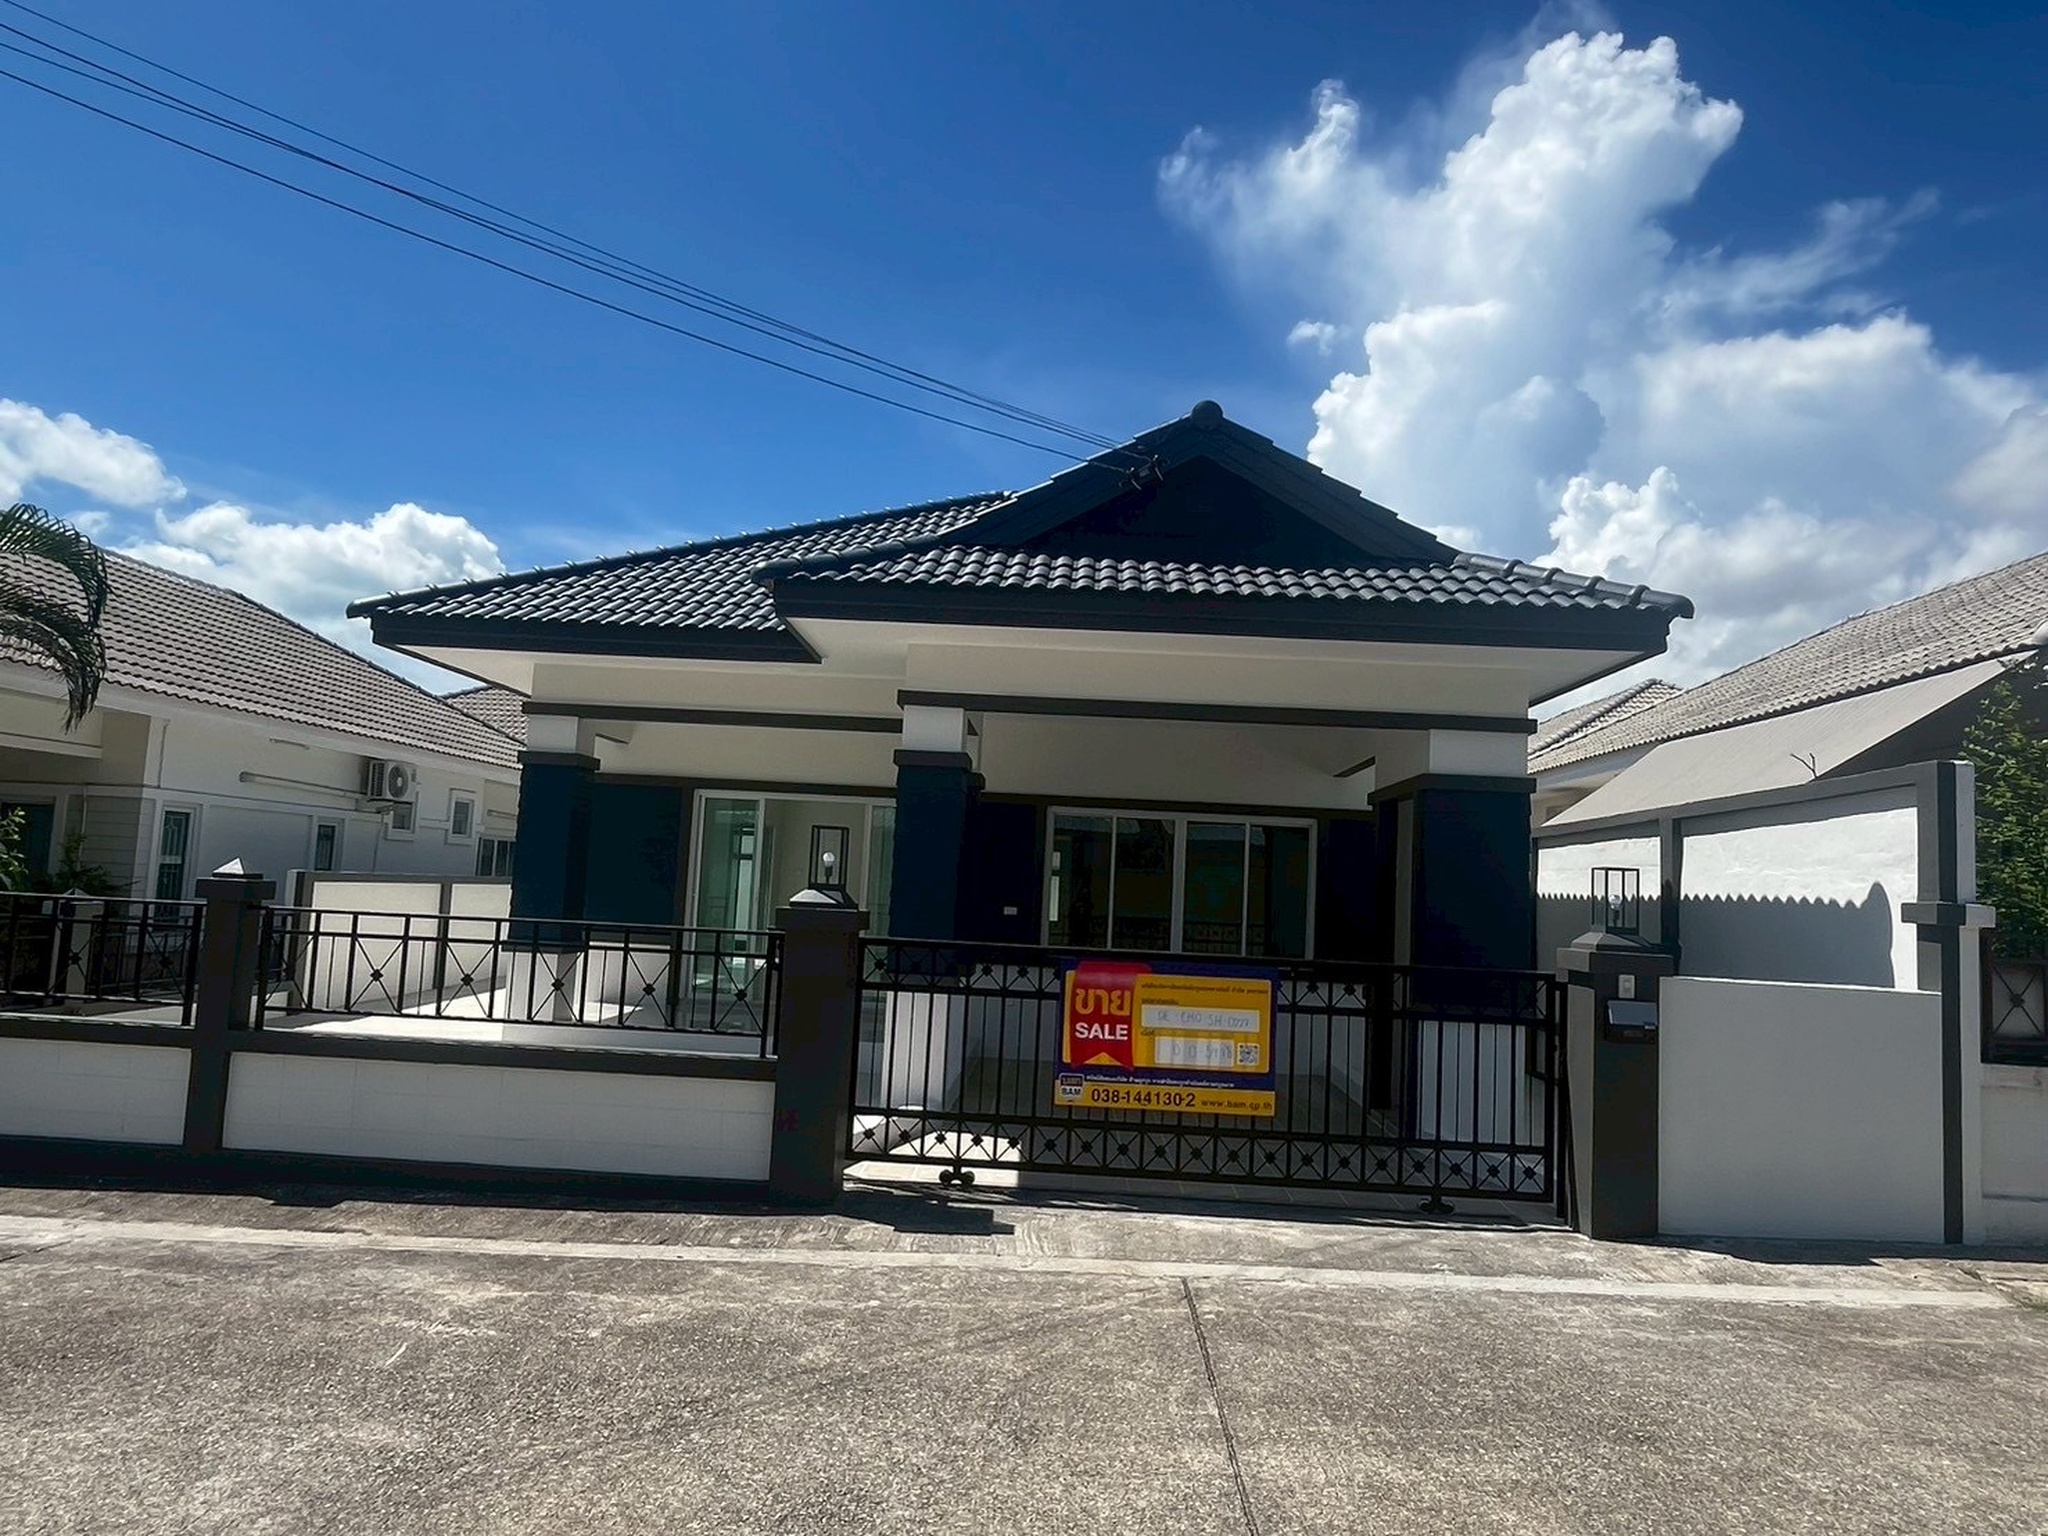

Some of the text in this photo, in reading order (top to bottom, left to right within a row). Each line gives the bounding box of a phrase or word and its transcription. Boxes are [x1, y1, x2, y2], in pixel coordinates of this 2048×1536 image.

[1075, 988, 1131, 1016] ขาย
[1075, 1022, 1129, 1040] SALE
[1061, 1087, 1082, 1096] BAM
[1091, 1088, 1197, 1108] 038-144130-2
